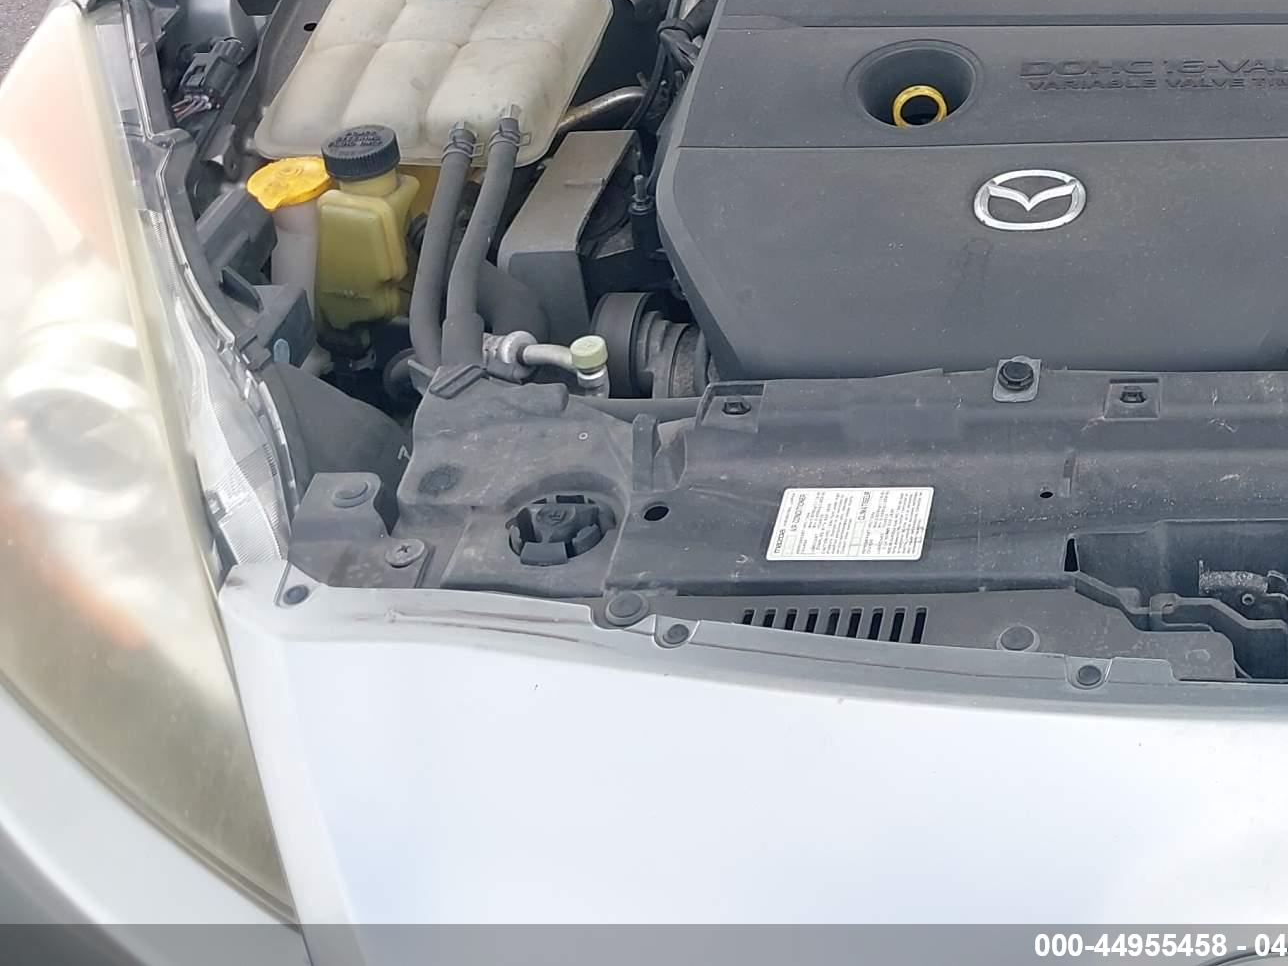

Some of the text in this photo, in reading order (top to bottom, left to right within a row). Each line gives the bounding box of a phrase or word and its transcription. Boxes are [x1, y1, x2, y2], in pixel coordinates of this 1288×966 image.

[1018, 57, 1155, 77] DOHC
[1027, 77, 1157, 91] VARIABLE
[1166, 77, 1245, 90] VALVE
